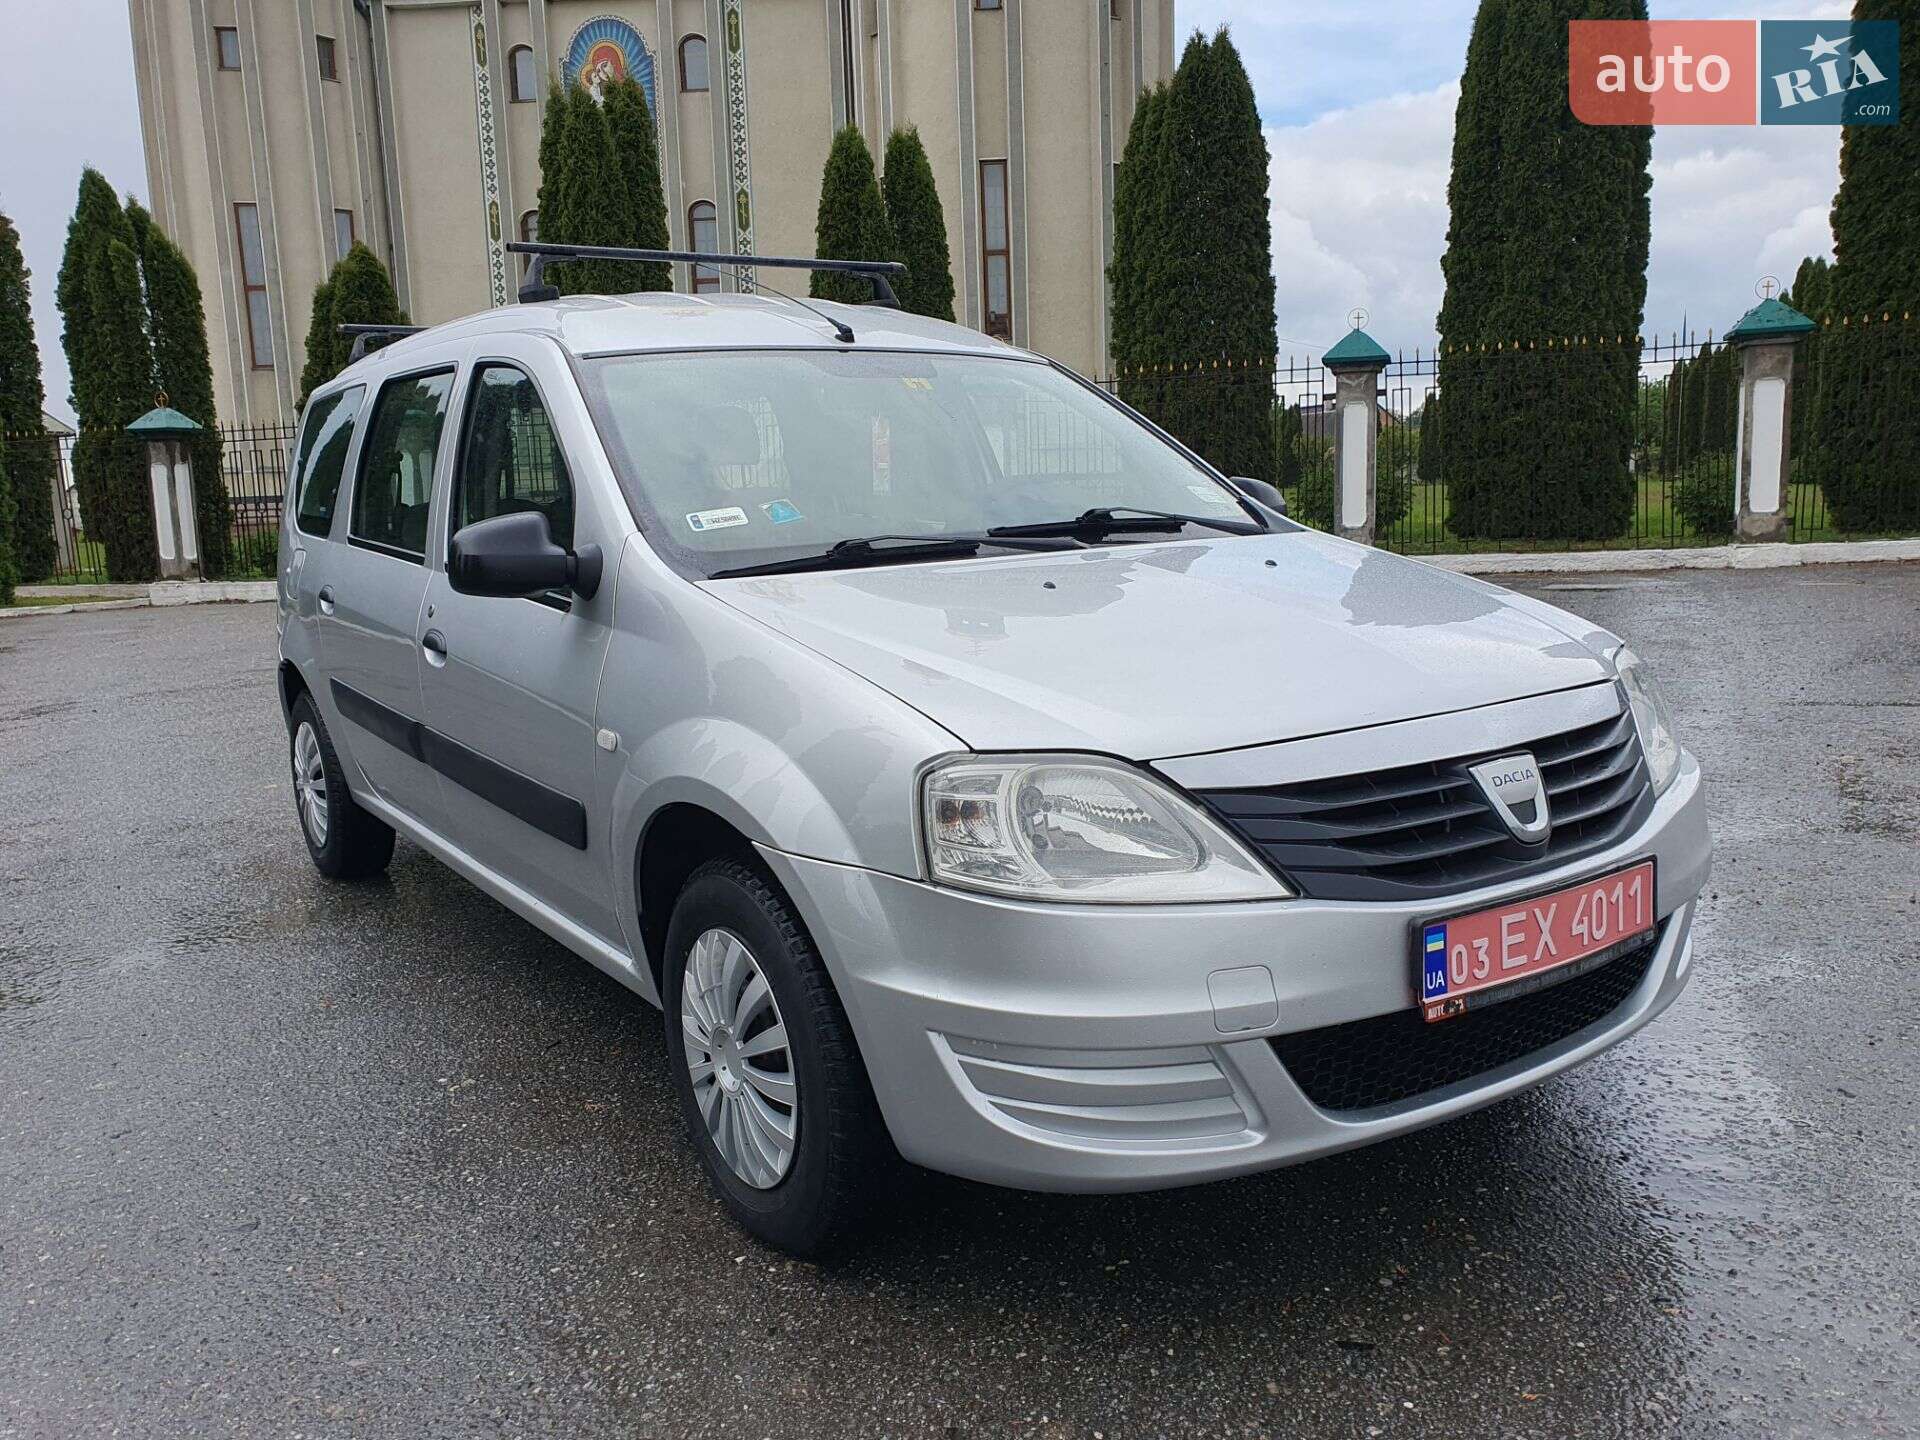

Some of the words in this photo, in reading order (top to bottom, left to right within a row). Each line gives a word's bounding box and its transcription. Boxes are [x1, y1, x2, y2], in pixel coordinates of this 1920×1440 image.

[1491, 768, 1535, 788] DACIA
[1451, 936, 1490, 985] 03
[1500, 902, 1558, 970] EX
[1570, 875, 1642, 946] 4011
[1426, 969, 1445, 990] UA
